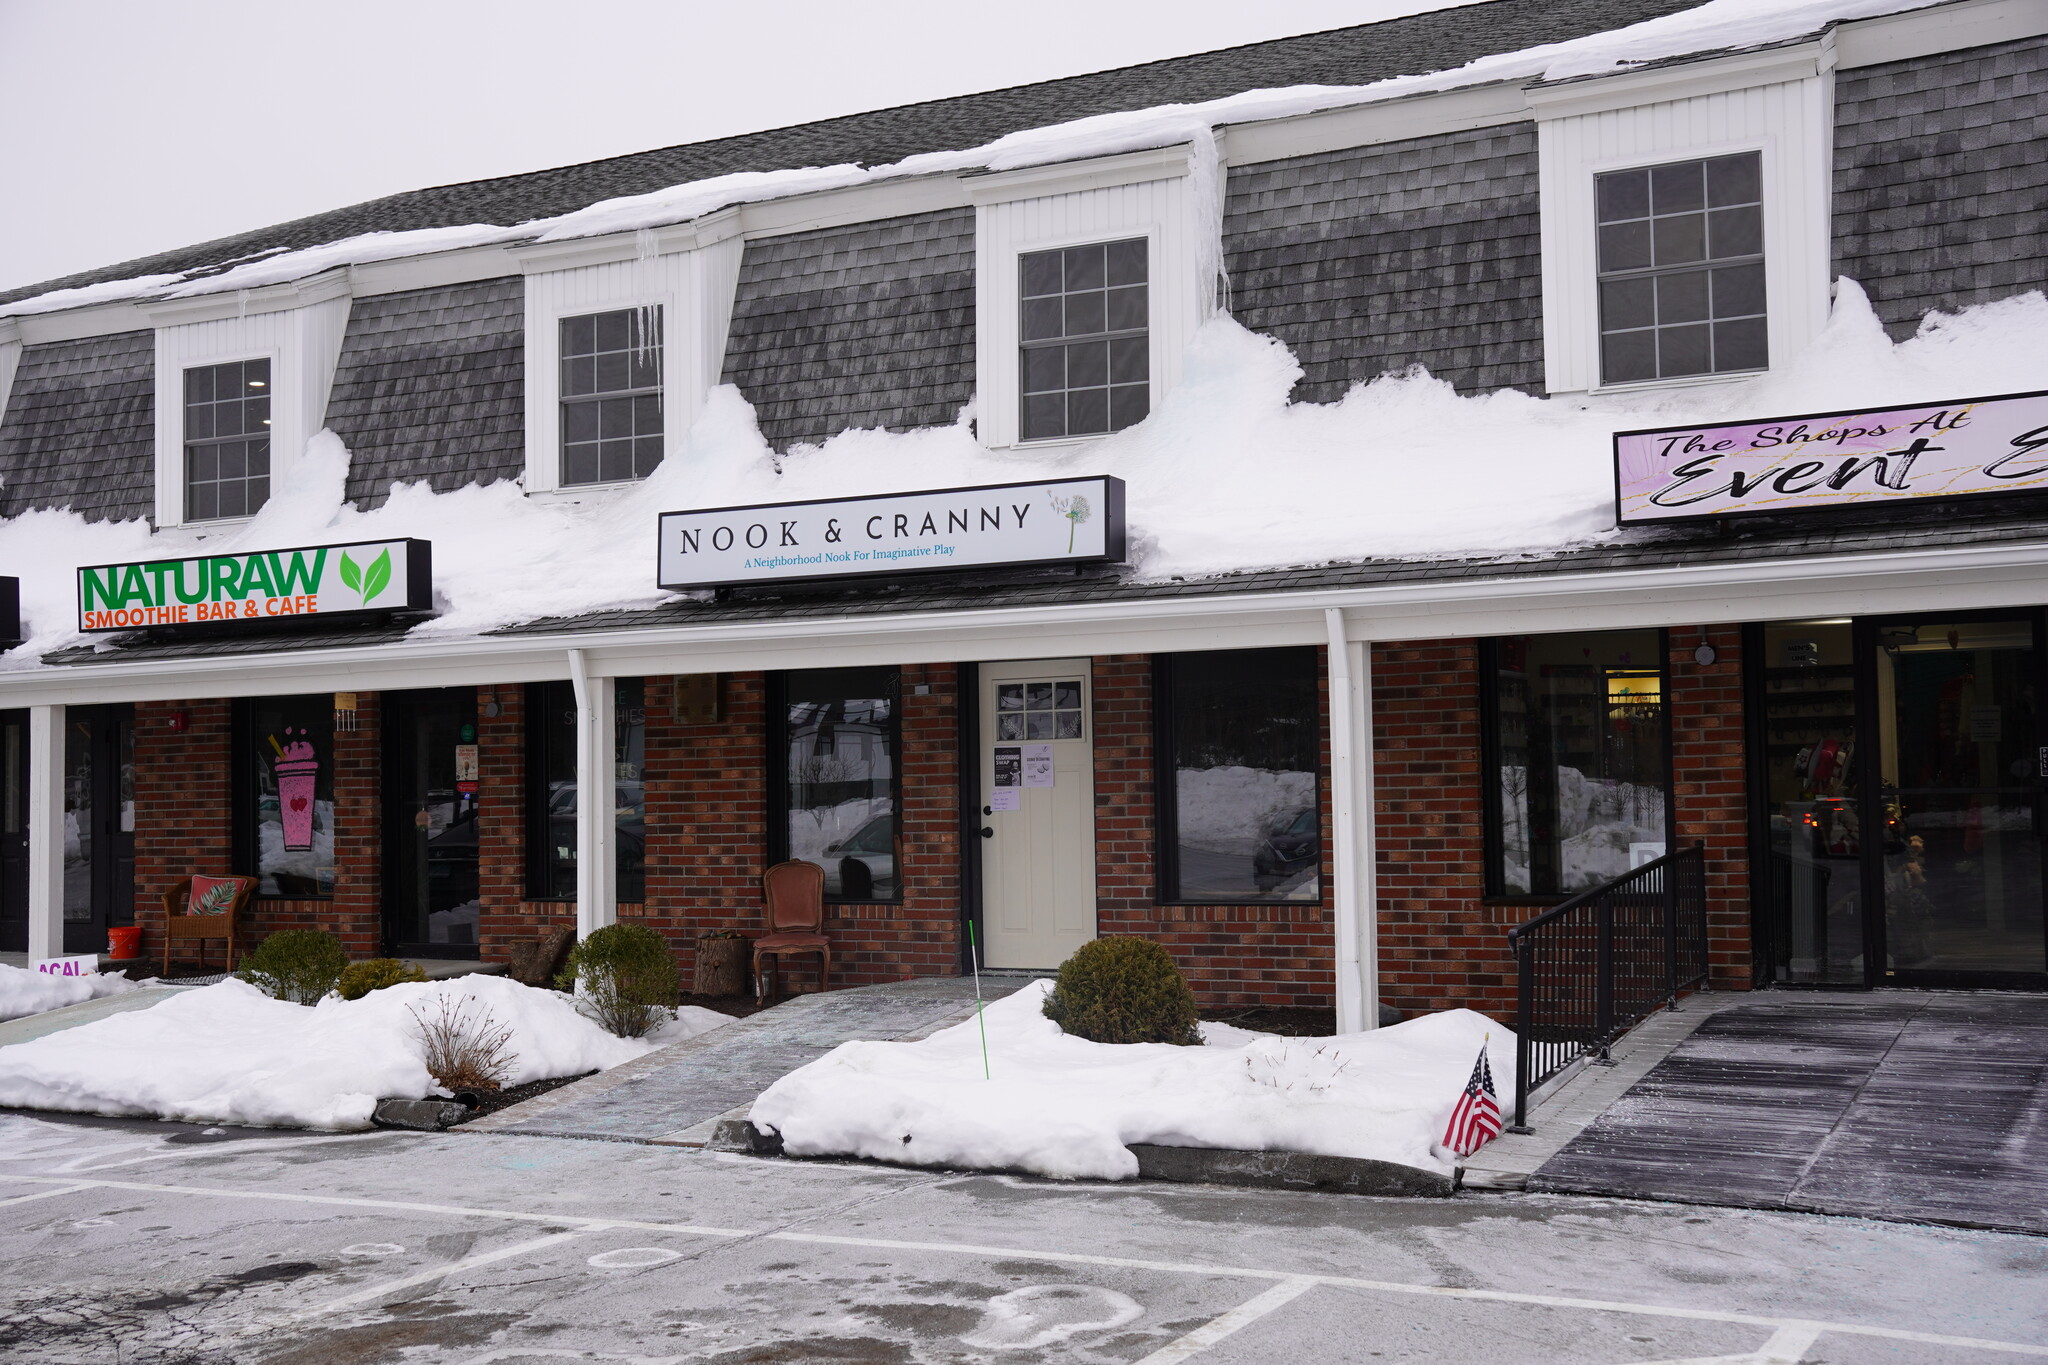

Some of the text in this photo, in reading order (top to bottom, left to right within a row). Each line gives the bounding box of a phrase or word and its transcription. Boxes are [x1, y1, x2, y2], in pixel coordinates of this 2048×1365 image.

[1657, 410, 1972, 457] The Shops At
[1649, 437, 1946, 508] Event
[680, 503, 1031, 554] NOOK & CRANNY
[83, 548, 329, 612] NATURAW
[744, 543, 956, 569] A Neighborhood Nook For Imaginative Play
[84, 594, 318, 629] SMOOTHIE BAR & CAFE
